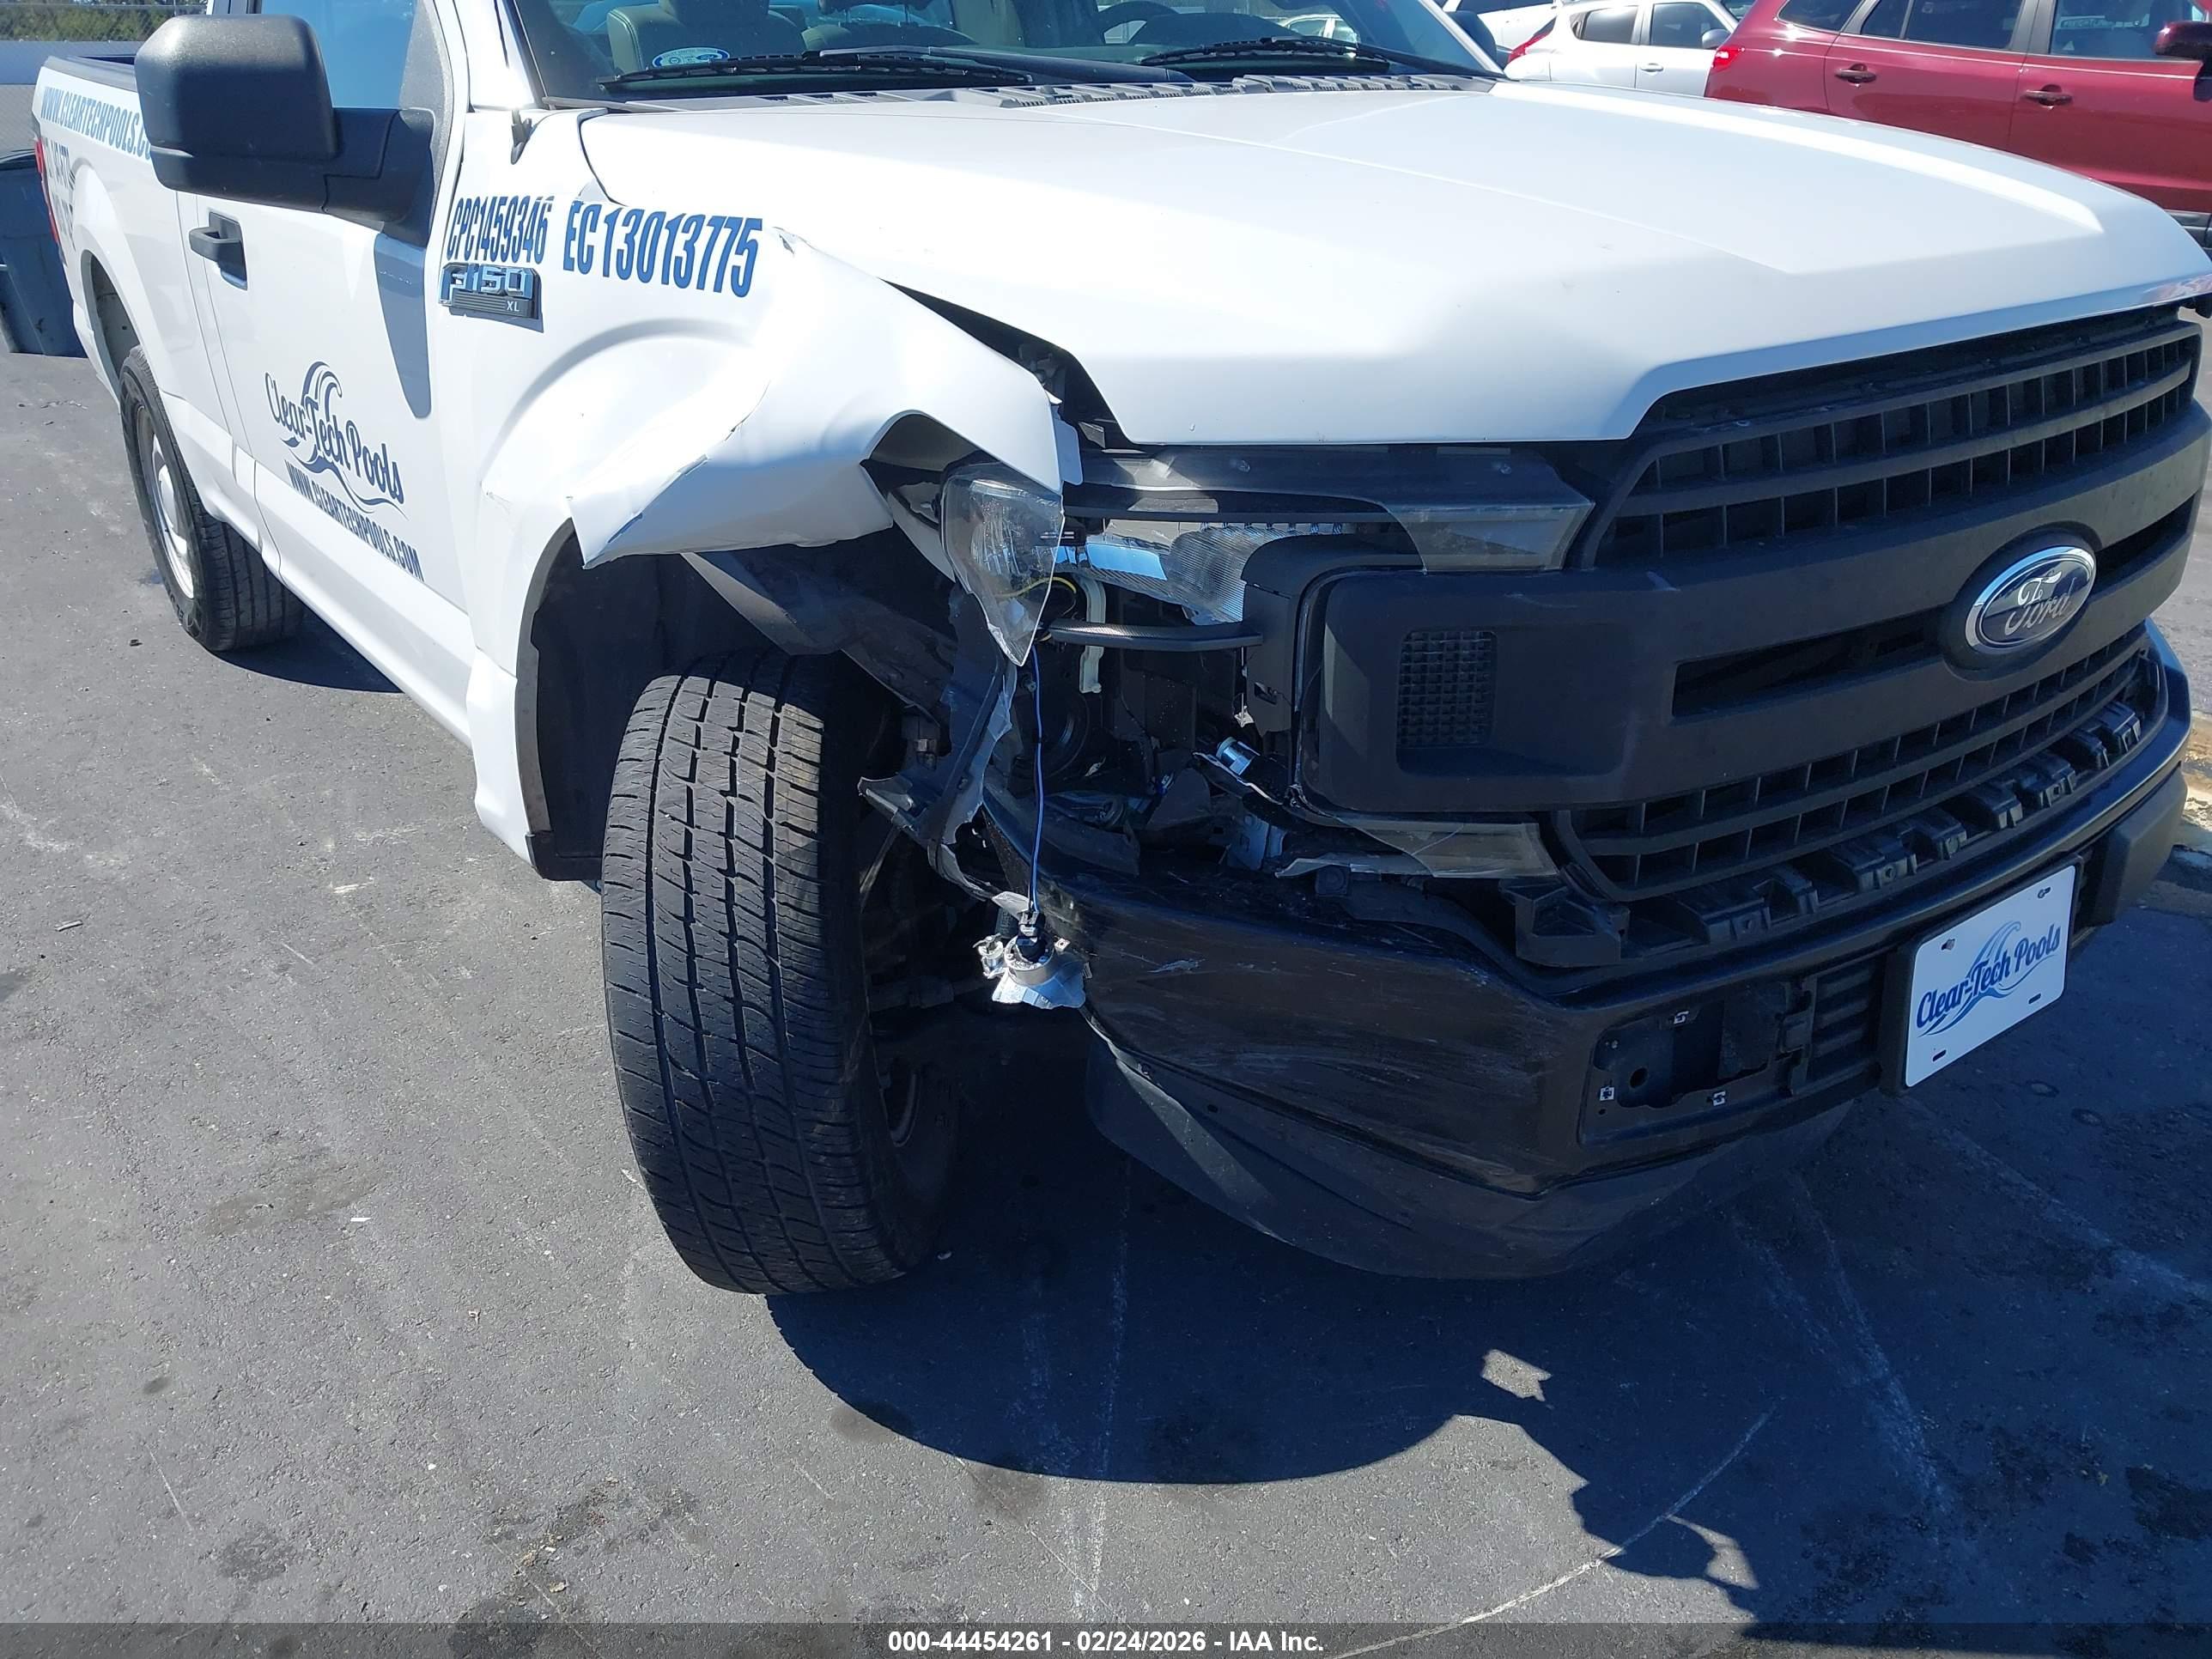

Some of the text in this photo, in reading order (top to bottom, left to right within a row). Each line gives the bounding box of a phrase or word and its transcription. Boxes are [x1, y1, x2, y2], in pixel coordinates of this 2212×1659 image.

[447, 195, 555, 264] CPC1459346
[507, 301, 520, 312] XL
[265, 373, 404, 504] Clear-Tech Pools
[284, 459, 424, 582] WWW.CLEARTECHPOOLS.COM
[2004, 571, 2077, 635] Ford
[1917, 923, 2062, 1029] Clear-Tech Pools
